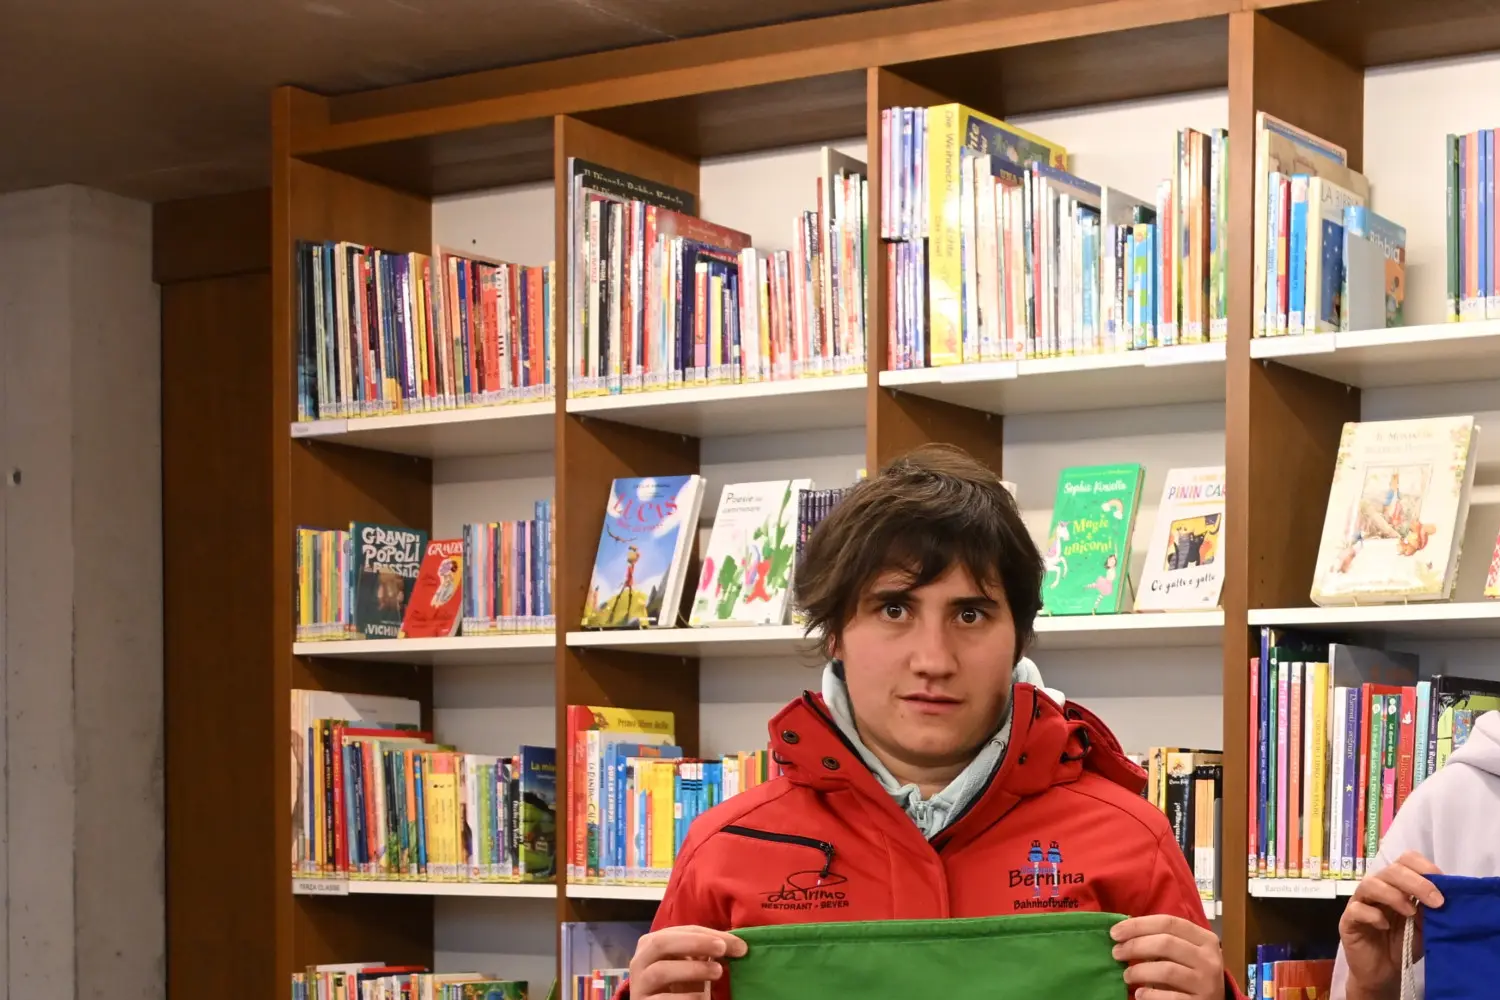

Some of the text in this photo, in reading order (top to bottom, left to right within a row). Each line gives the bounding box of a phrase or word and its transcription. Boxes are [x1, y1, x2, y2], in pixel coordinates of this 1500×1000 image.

[1168, 484, 1202, 500] PININ
[362, 527, 420, 549] GRANDI
[362, 543, 420, 570] POPOLI
[1008, 869, 1084, 889] Bernina
[760, 899, 850, 911] RESTORANT BEVER
[1013, 898, 1080, 911] Bahnhofbuffet
